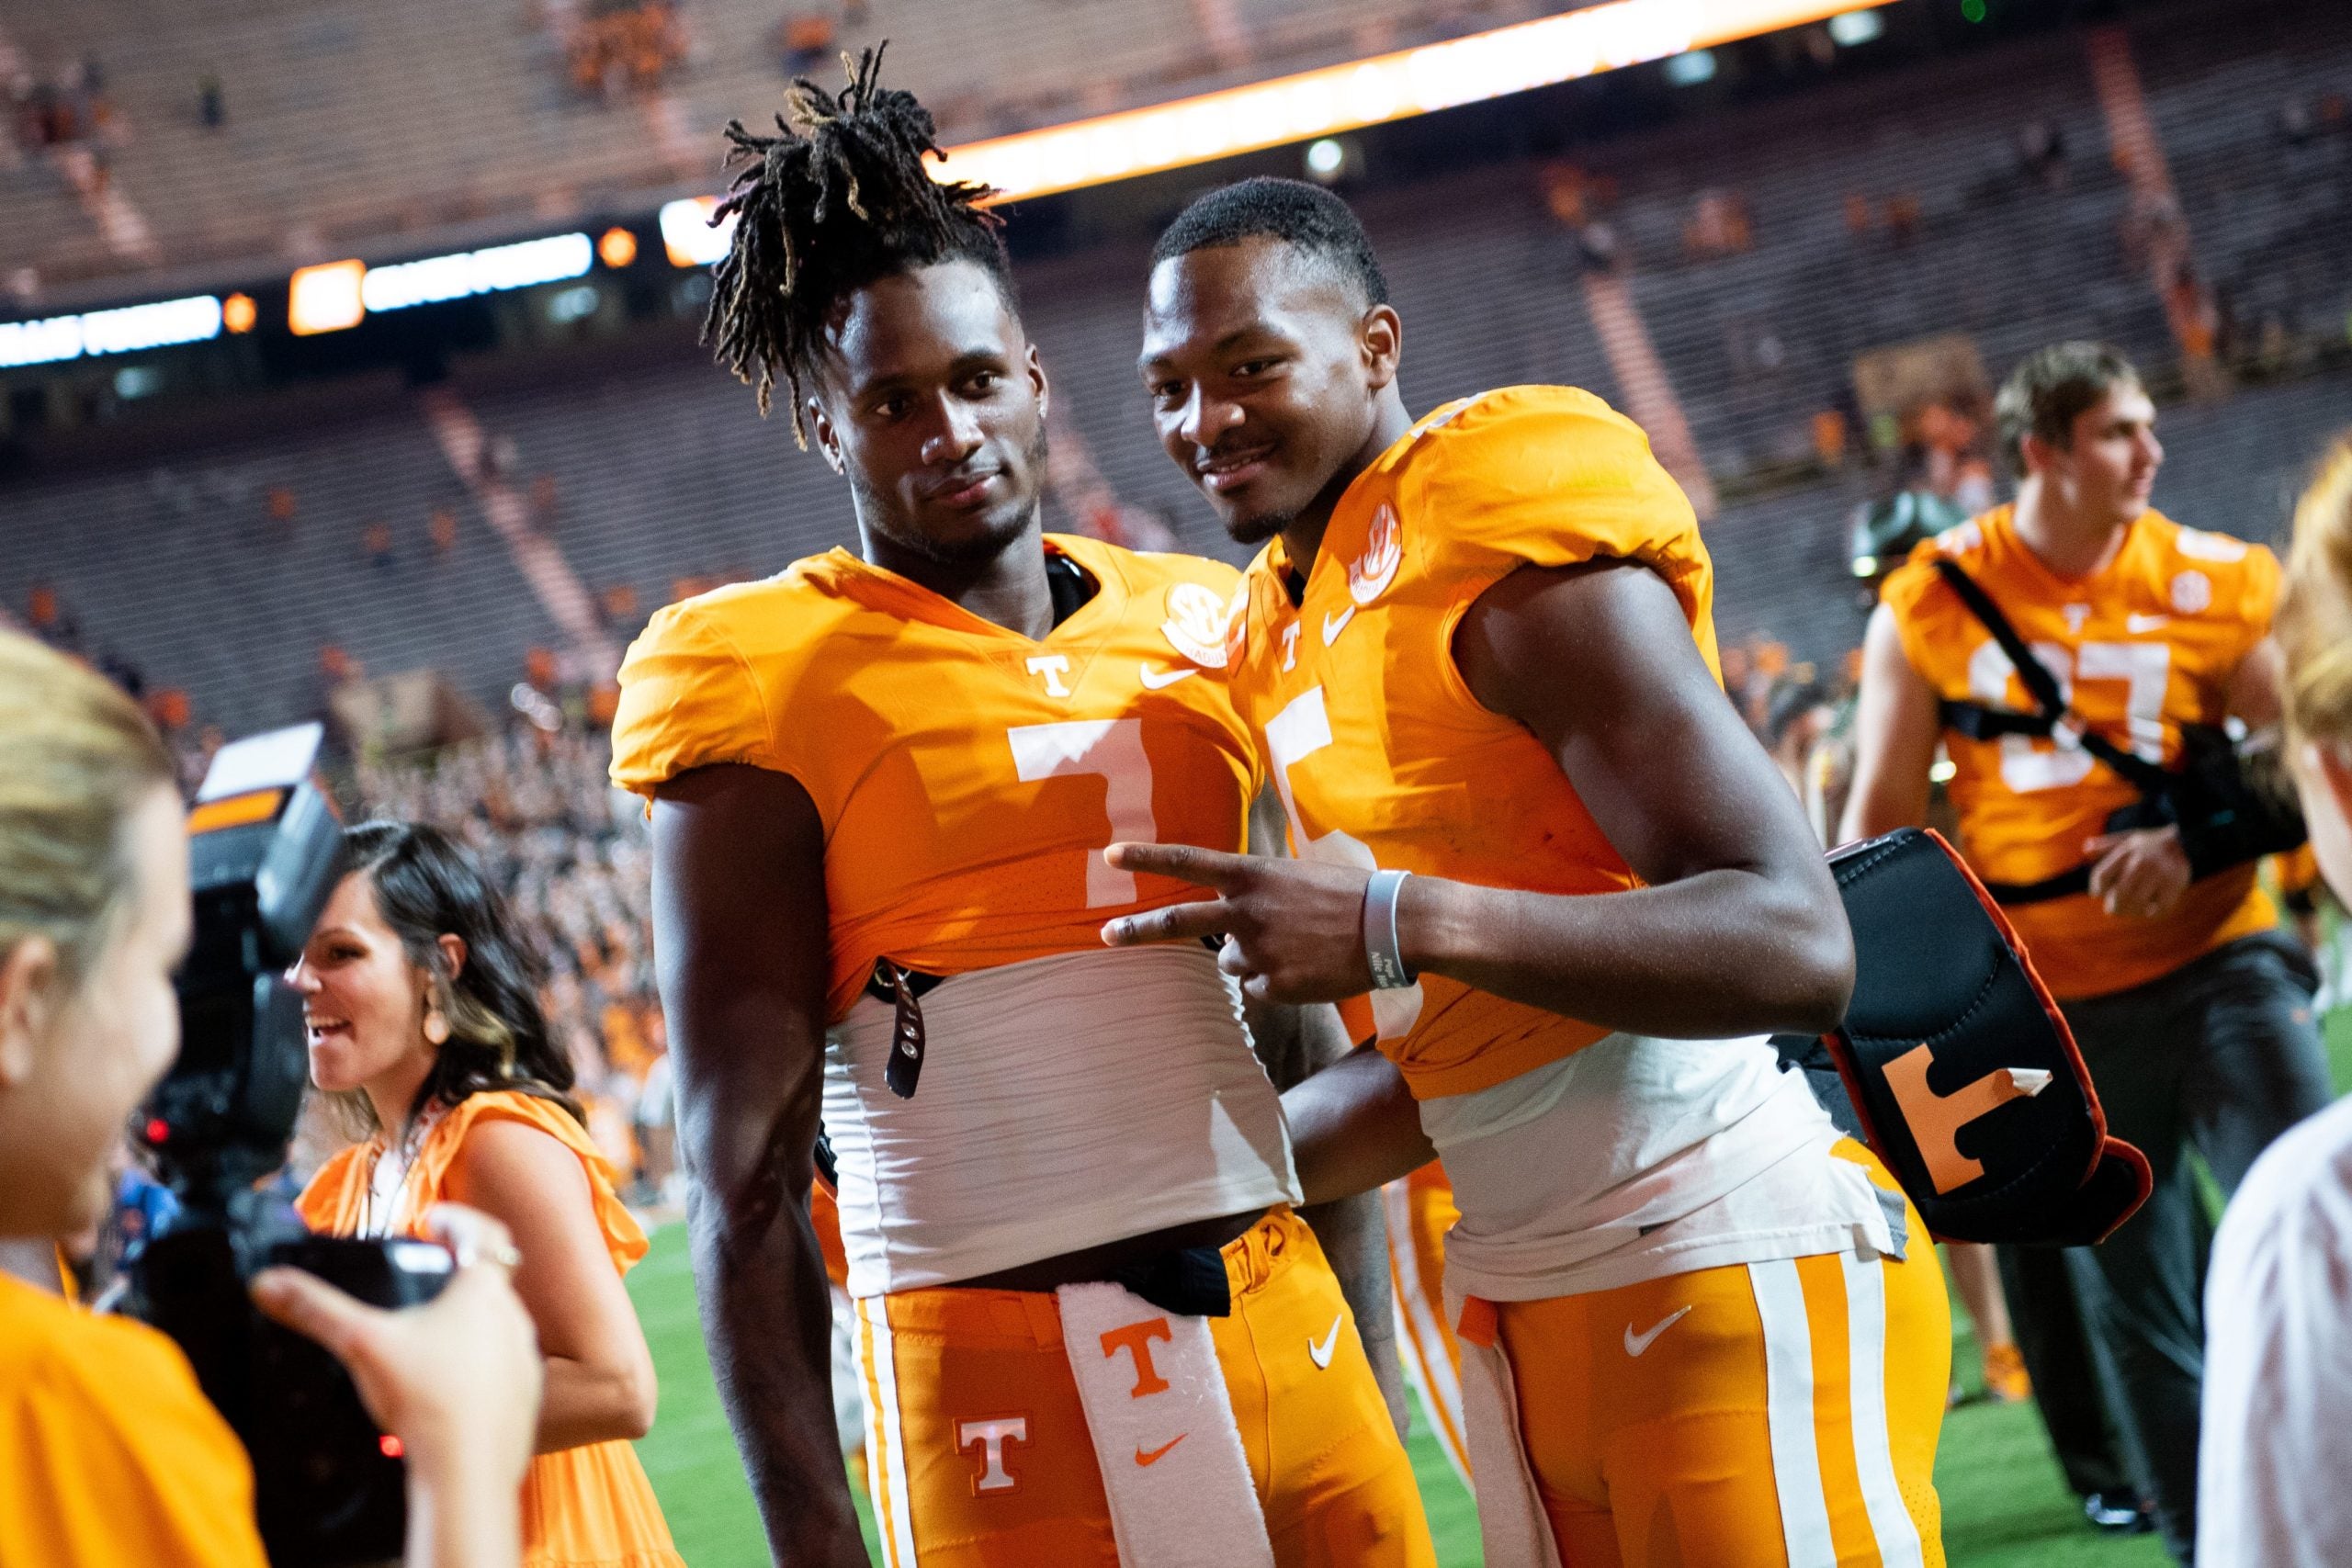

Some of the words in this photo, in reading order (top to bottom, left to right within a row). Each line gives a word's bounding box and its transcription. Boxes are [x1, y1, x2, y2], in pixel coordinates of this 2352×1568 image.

[1026, 655, 1069, 697] T
[1282, 617, 1301, 672] T
[1007, 717, 1157, 908] 7
[1101, 1317, 1172, 1399] T
[959, 1416, 1028, 1492] T
